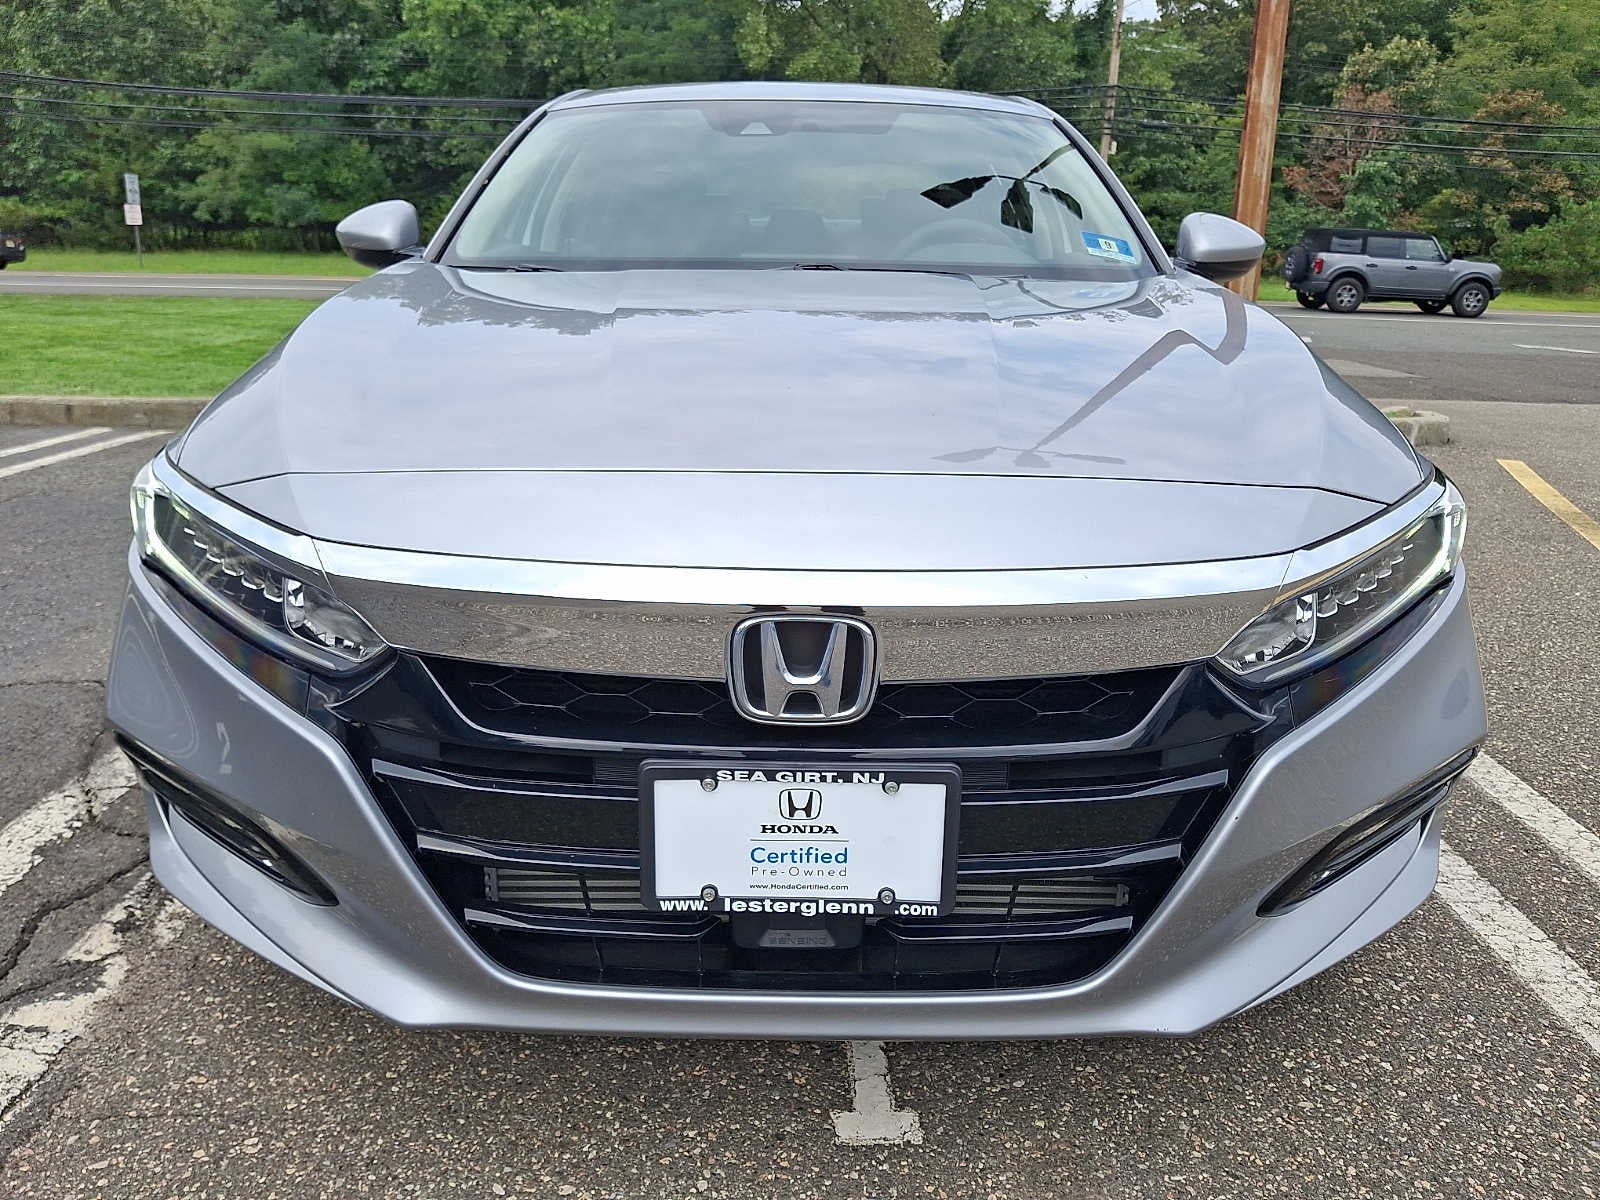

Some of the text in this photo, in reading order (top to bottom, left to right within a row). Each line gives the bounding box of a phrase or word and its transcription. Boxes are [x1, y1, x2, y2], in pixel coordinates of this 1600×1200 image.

[716, 770, 885, 785] SEA GIRT, NJ
[760, 824, 839, 835] HONDA
[750, 846, 848, 864] Certified
[751, 866, 847, 877] Pre-Owned
[749, 883, 849, 891] www.HondaCertified.com
[659, 897, 938, 916] www. lesterglenn .com
